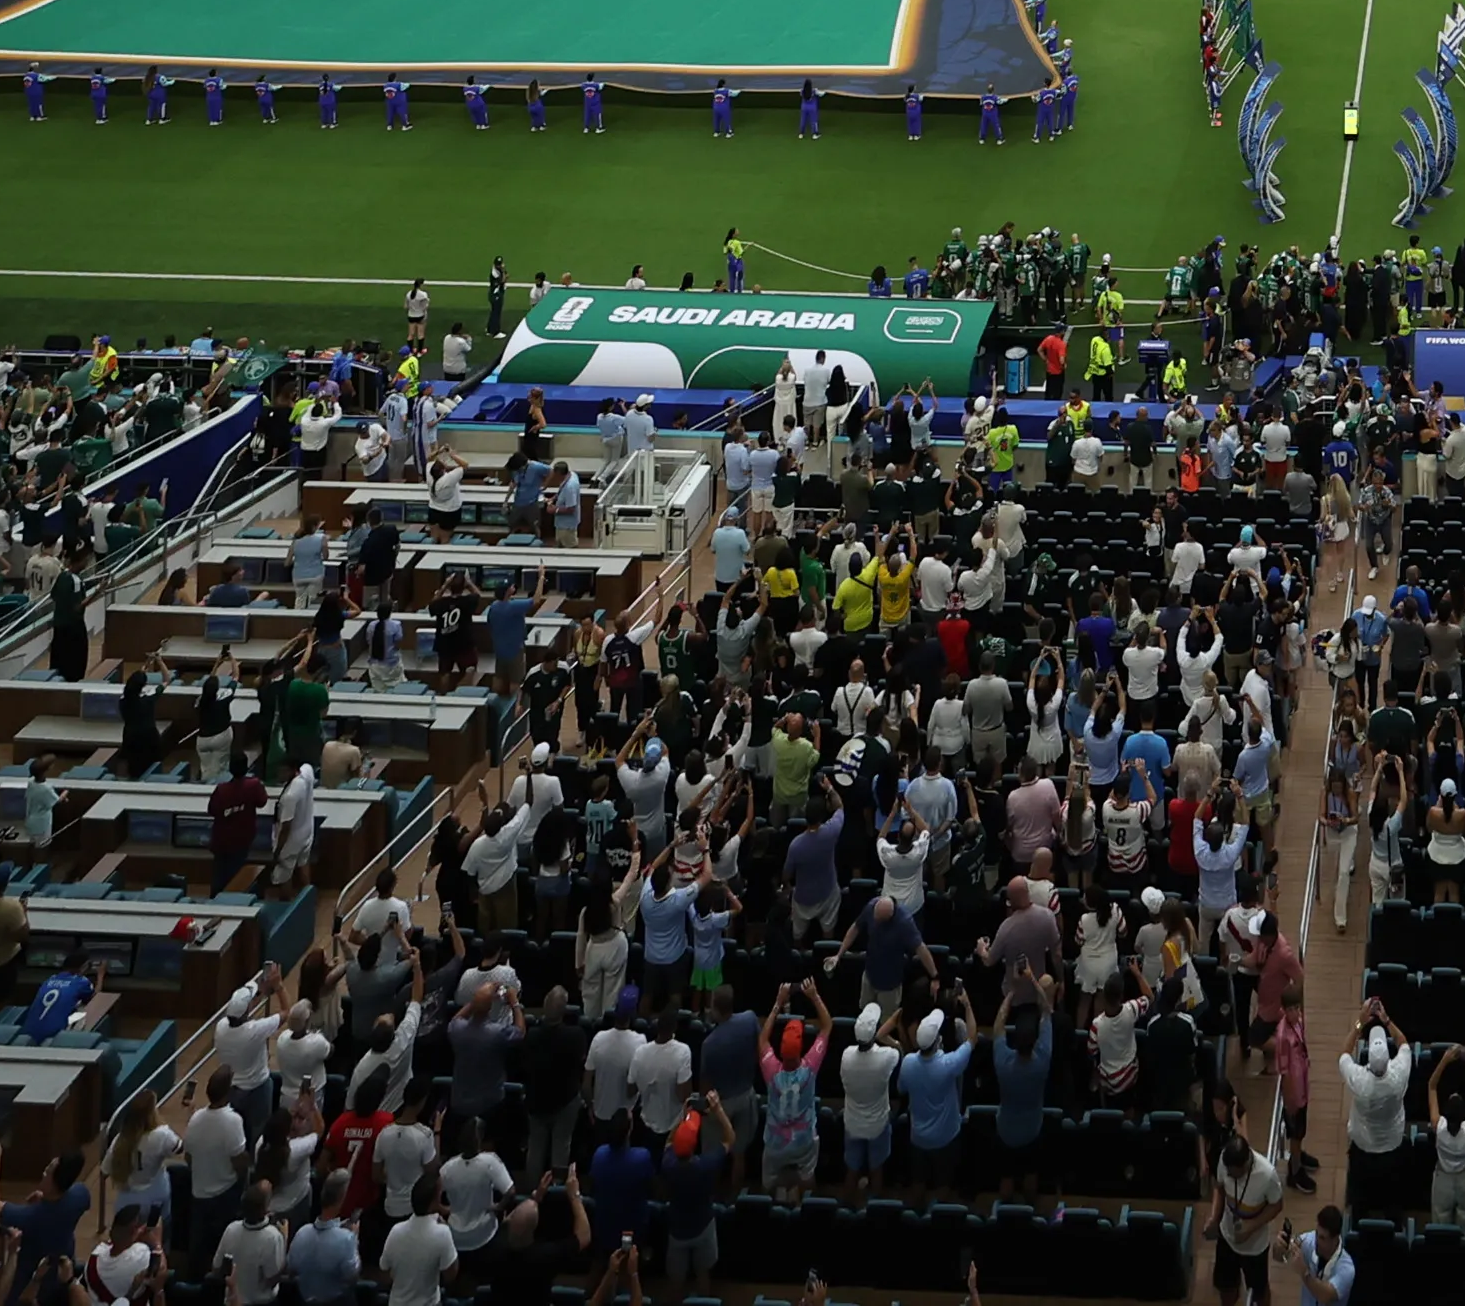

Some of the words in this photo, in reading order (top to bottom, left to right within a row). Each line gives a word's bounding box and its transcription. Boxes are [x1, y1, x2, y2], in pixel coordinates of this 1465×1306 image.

[608, 304, 716, 326] SAUDI
[717, 309, 856, 332] ARABIA
[1425, 336, 1449, 345] FIFA
[1332, 450, 1347, 467] 10
[441, 607, 461, 628] 10
[611, 652, 631, 669] 71
[666, 654, 677, 669] 0
[1116, 828, 1126, 846] 8
[38, 989, 60, 1021] 9
[343, 1128, 373, 1139] RONALDO
[347, 1140, 364, 1170] 7
